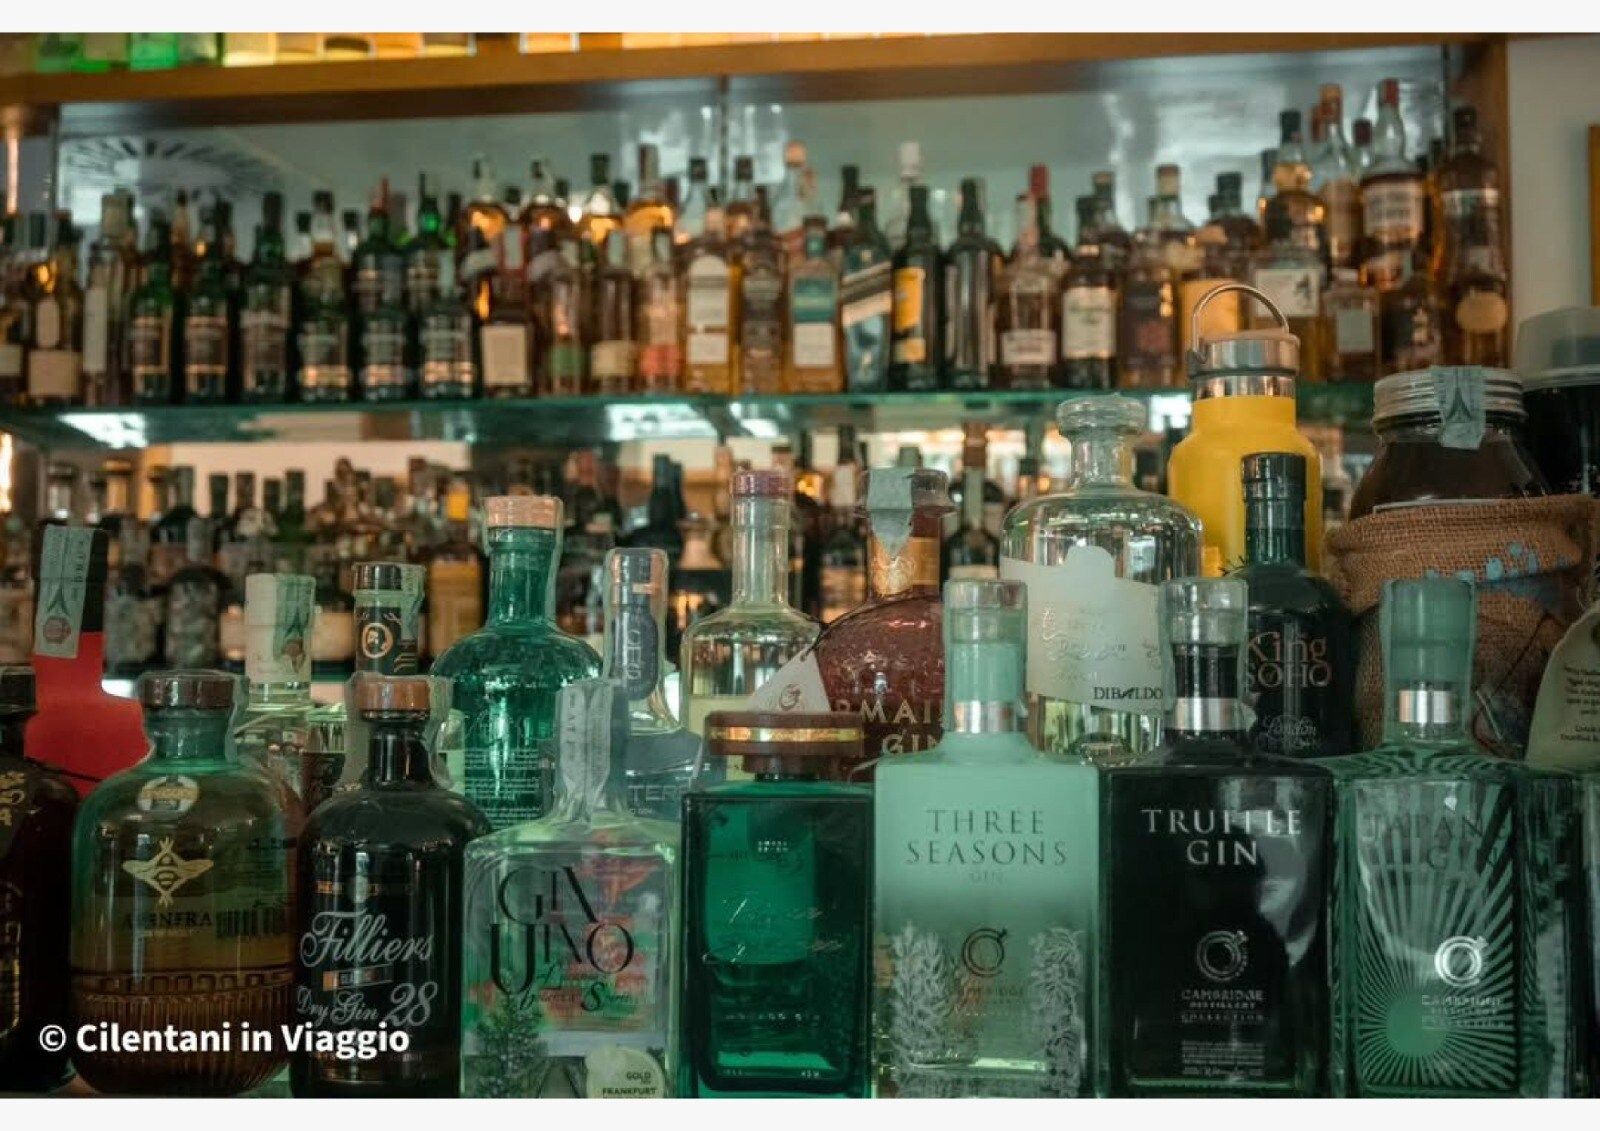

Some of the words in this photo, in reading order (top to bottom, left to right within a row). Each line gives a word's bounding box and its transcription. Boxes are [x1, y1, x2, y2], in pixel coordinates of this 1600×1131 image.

[926, 809, 1044, 835] THREE
[906, 841, 1068, 866] SEASONS
[1186, 840, 1259, 867] GIN
[300, 907, 435, 968] Filliers
[330, 990, 379, 1025] Gin
[382, 982, 438, 1027] 28
